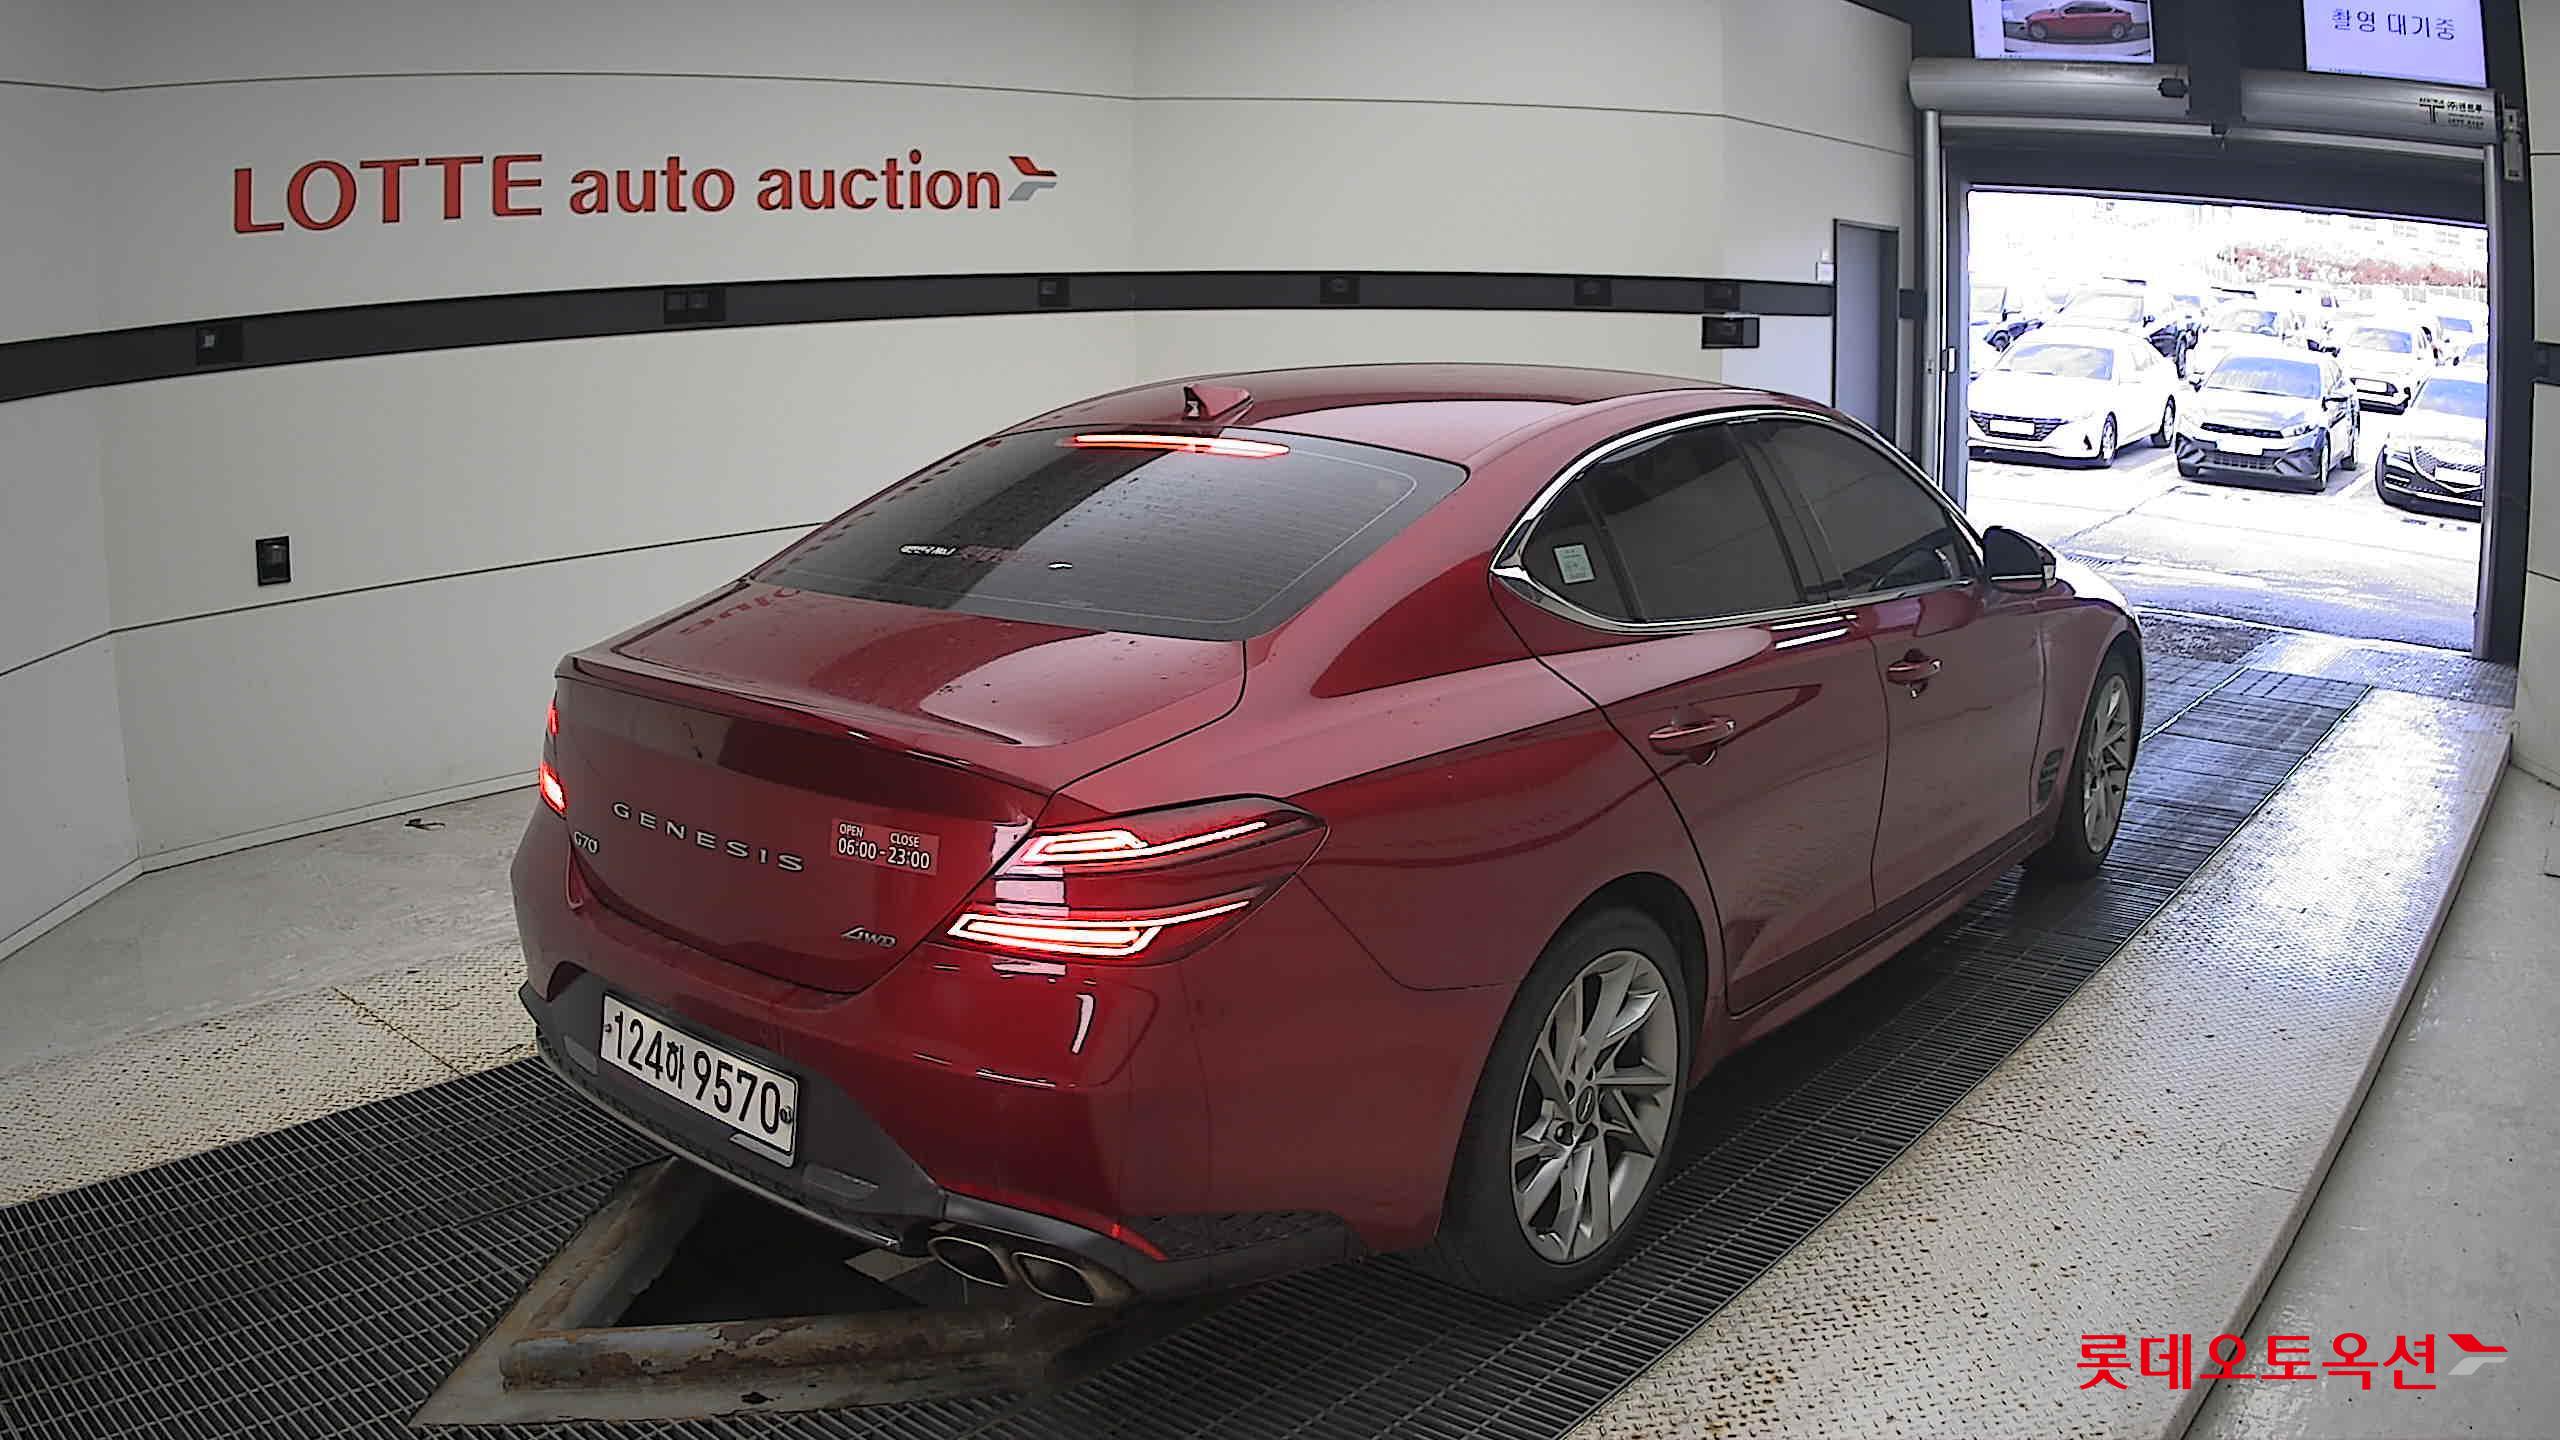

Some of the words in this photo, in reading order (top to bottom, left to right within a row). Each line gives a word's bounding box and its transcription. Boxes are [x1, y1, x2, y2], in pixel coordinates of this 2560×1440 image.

[2331, 8, 2375, 32] 촬영
[2386, 13, 2455, 40] 대기중
[234, 153, 543, 234] LOTTE
[569, 155, 735, 214] auto
[757, 149, 1001, 210] auction
[574, 831, 598, 853] G70
[612, 802, 804, 872] GENESIS
[839, 823, 863, 838] OPEN
[890, 833, 920, 847] CLOSE
[614, 1010, 684, 1090] 124하
[693, 1050, 781, 1134] 9570
